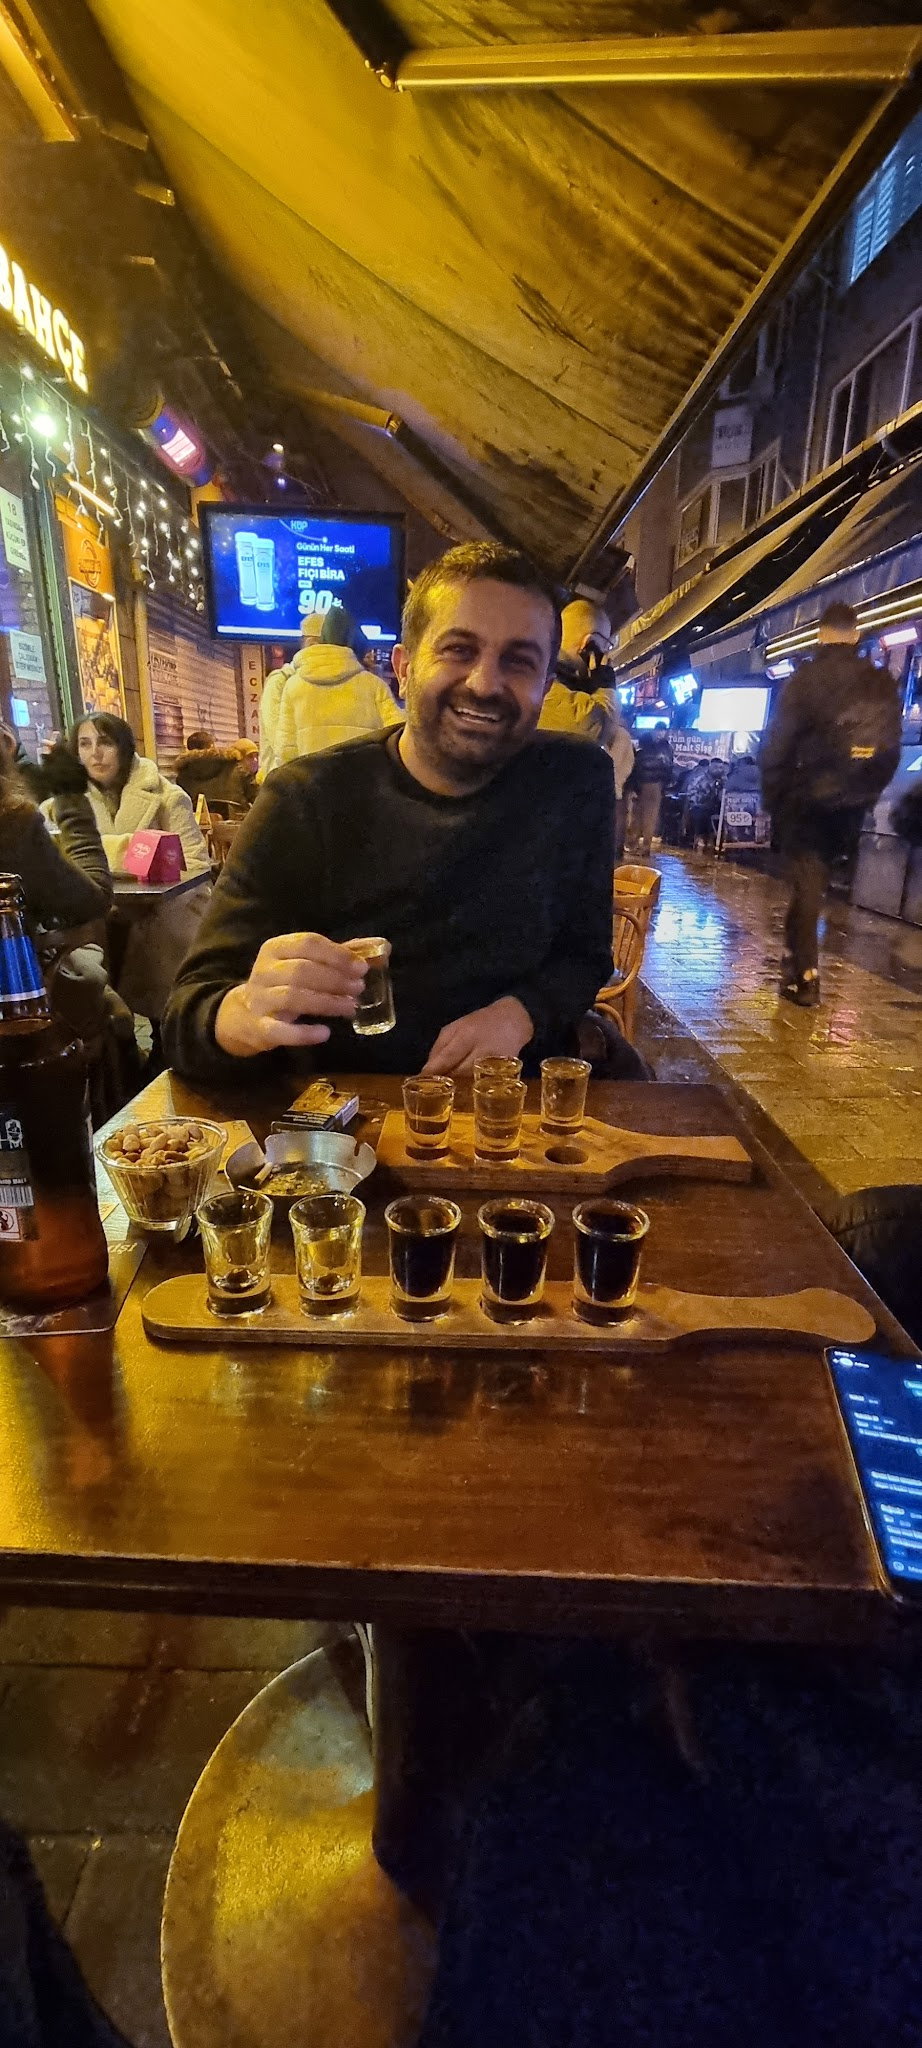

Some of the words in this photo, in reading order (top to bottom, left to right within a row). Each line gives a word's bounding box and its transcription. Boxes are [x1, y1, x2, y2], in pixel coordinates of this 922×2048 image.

[0, 242, 88, 394] BAHÇE
[296, 541, 319, 551] Günün
[320, 543, 333, 552] Her
[334, 544, 355, 554] Saati
[297, 556, 324, 567] EFES
[297, 567, 318, 580] FIÇI
[319, 566, 345, 581] BİRA
[248, 660, 260, 748] ECZAN
